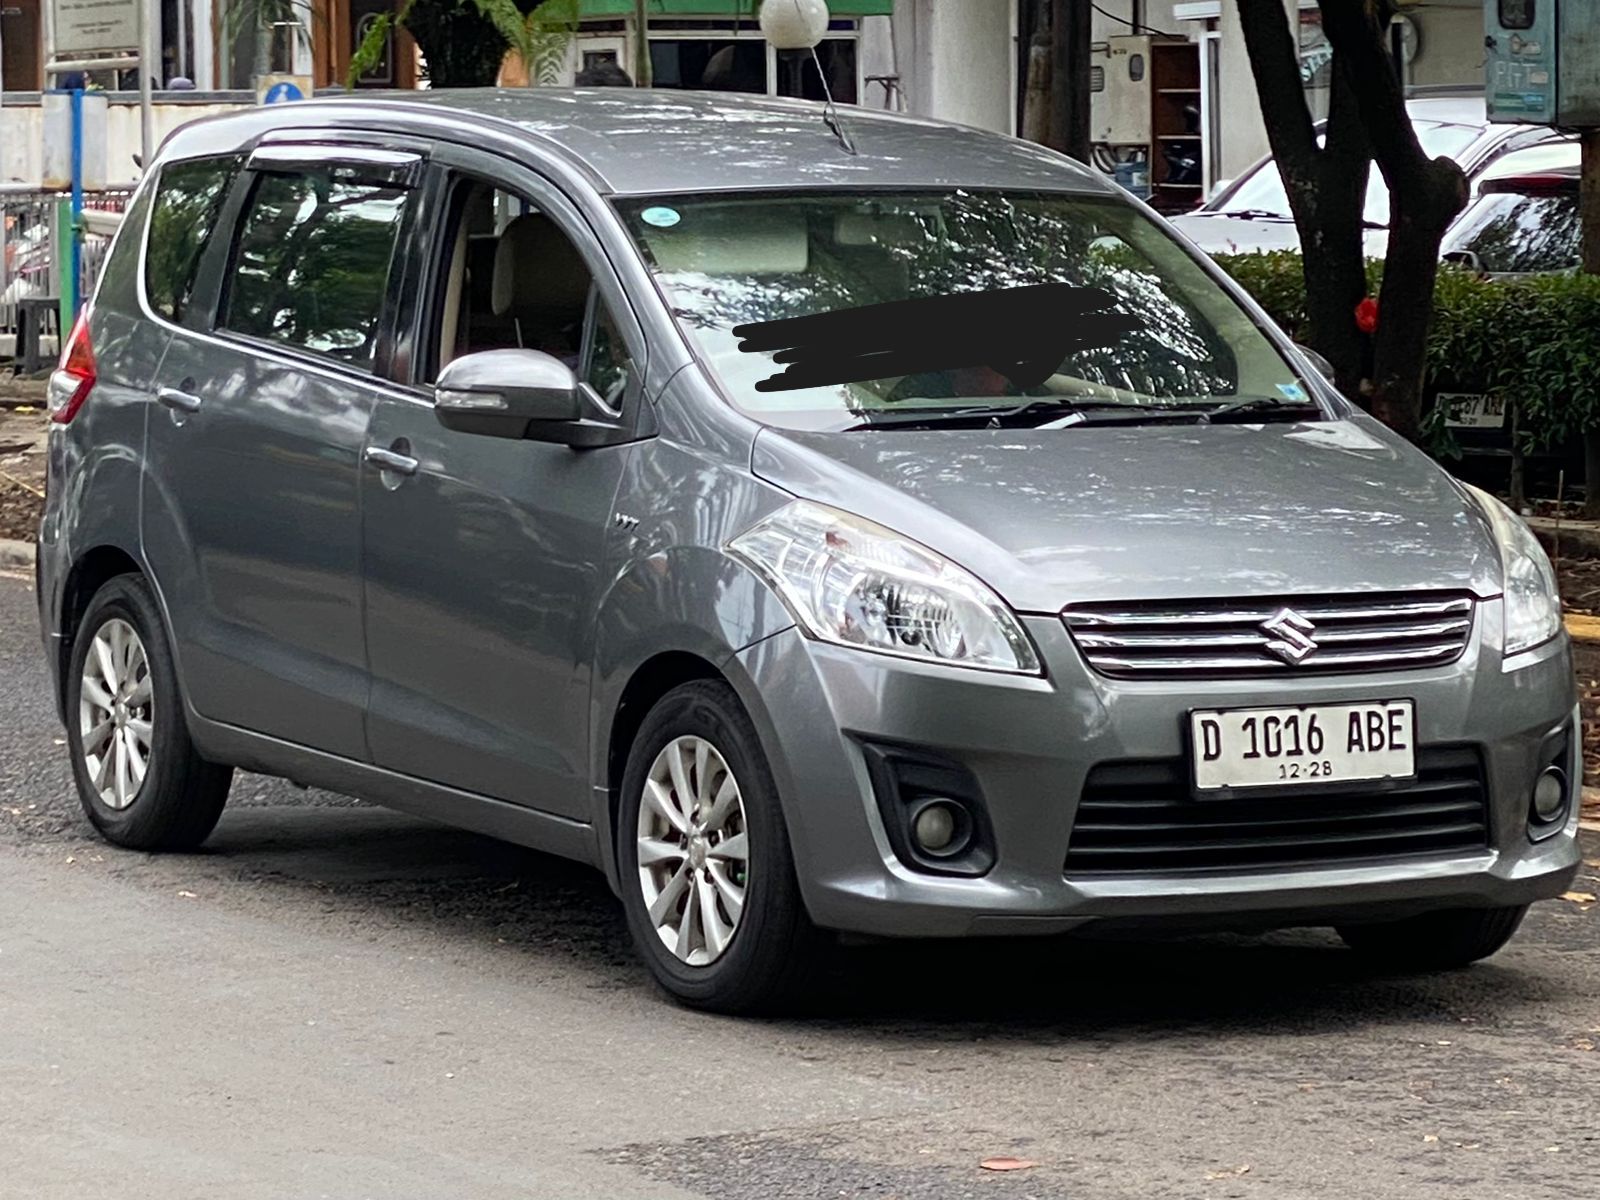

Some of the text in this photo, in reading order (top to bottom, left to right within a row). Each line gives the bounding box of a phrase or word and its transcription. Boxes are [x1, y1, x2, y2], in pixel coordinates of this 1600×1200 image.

[1200, 708, 1407, 761] D 1016 ABE
